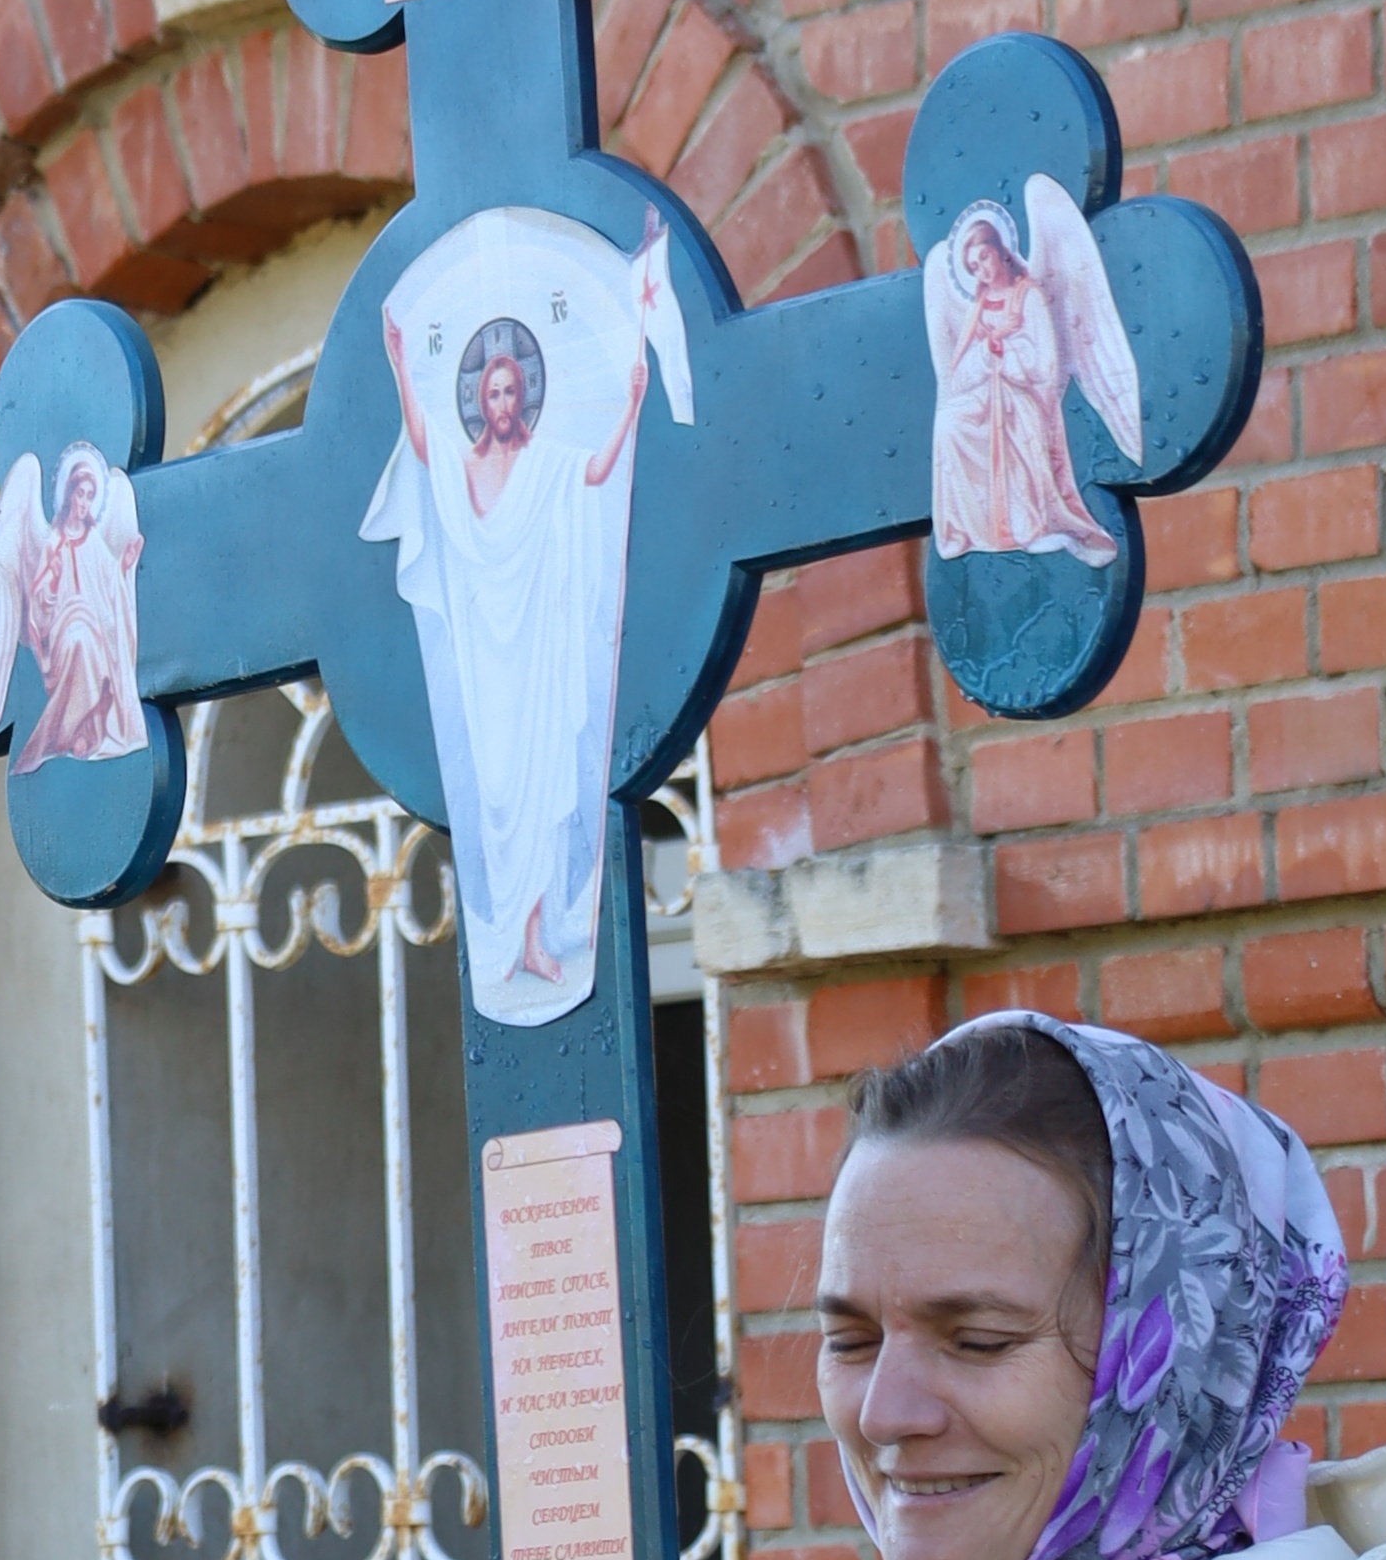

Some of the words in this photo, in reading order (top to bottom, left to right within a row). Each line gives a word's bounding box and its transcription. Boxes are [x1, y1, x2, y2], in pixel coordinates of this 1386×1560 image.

[500, 1195, 600, 1224] ВОСКРЕСЕНИЕ
[530, 1238, 573, 1259] ТВОЕ
[497, 1278, 556, 1302] ХРИСТЕ
[562, 1271, 610, 1294] СПАСЕ,
[499, 1315, 559, 1341] АНГЕЛИ
[562, 1307, 614, 1330] ПОЮТ
[511, 1357, 532, 1376] НА
[499, 1397, 513, 1415] И
[516, 1394, 545, 1414] НАС
[546, 1391, 567, 1410] НА
[569, 1383, 622, 1407] ЗЕМЛИ
[529, 1425, 597, 1450] СПОДОБИ
[529, 1464, 599, 1486] ЧИСТЫМ
[532, 1502, 600, 1526] СЕРДЦЕМ
